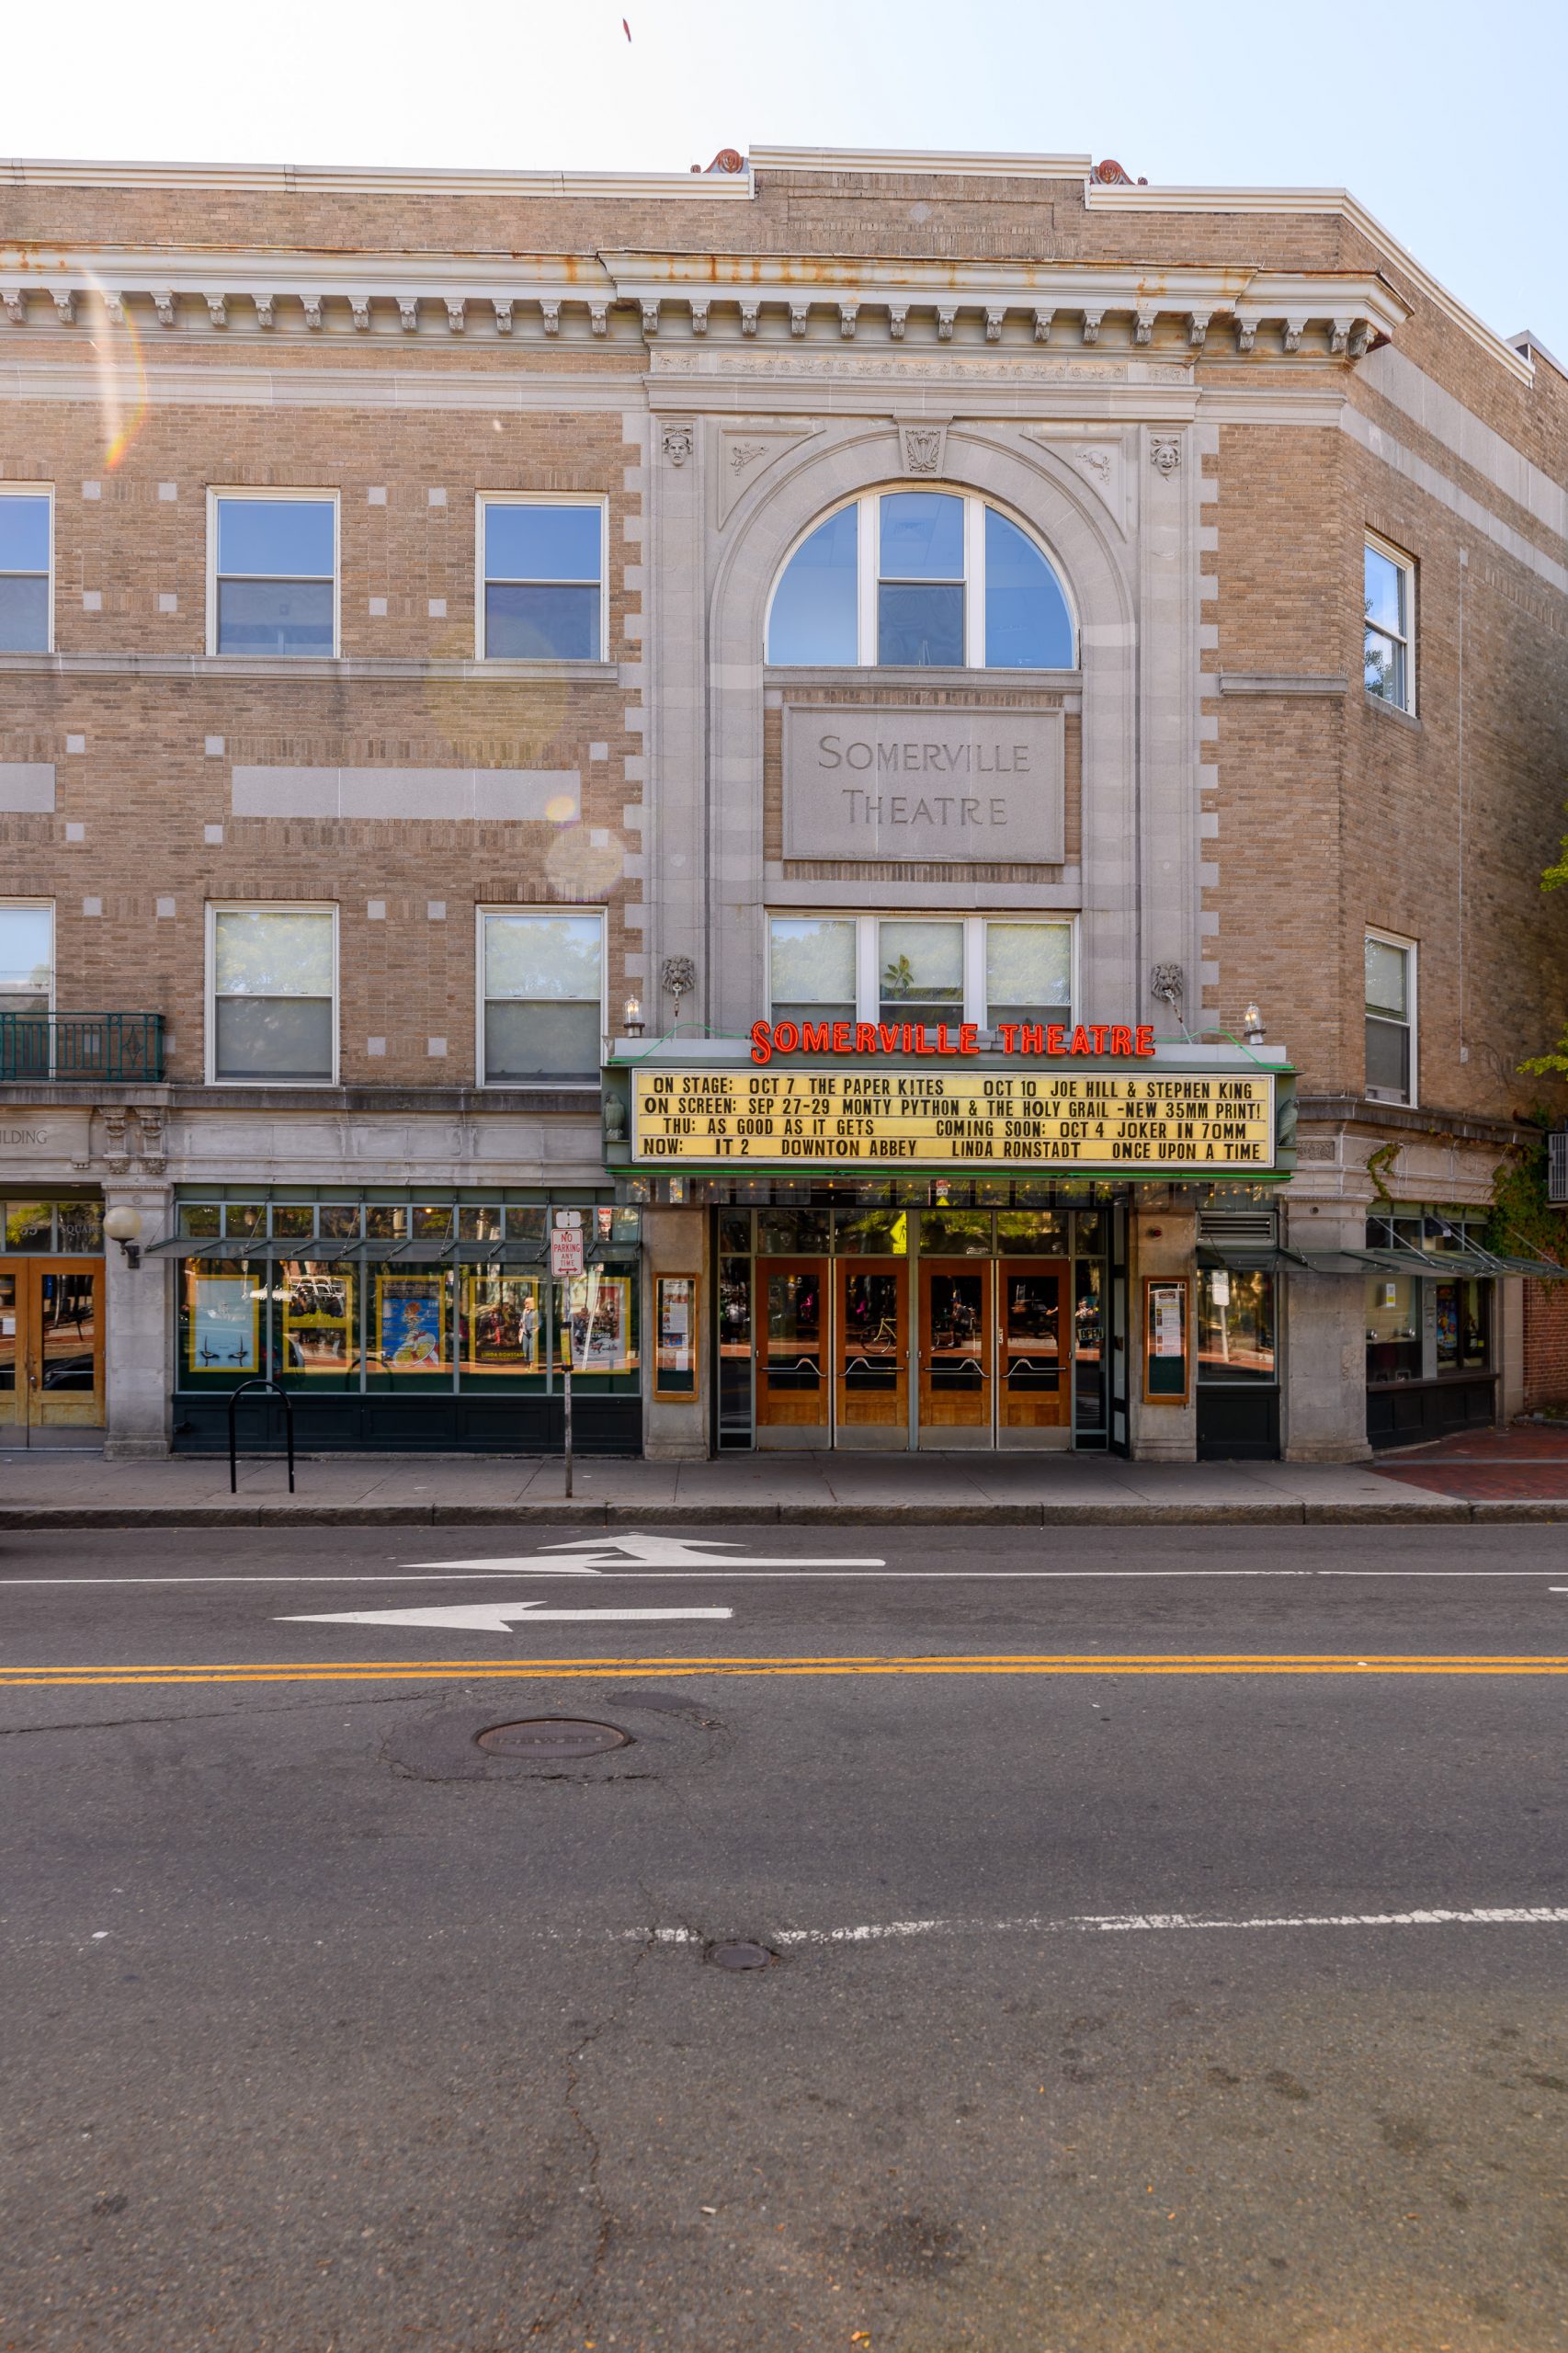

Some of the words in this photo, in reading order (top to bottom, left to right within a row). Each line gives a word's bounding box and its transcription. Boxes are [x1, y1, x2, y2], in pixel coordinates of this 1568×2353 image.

[818, 735, 1030, 772] SOMERVILLE
[842, 789, 1008, 825] THEATRE
[751, 1020, 980, 1064] SOMERVILLE
[999, 1024, 1155, 1056] THEATRE
[653, 1076, 674, 1094] ON
[683, 1077, 733, 1094] STAGE:
[749, 1078, 779, 1095] OCT
[787, 1078, 795, 1095] 7
[809, 1078, 835, 1096] THE
[844, 1079, 890, 1096] PAPER
[898, 1079, 944, 1097] KITES
[983, 1080, 1013, 1097] OCT
[1022, 1081, 1037, 1097] 10
[1051, 1081, 1077, 1098] JOE
[1086, 1082, 1118, 1098] HILL
[1127, 1082, 1136, 1098] &
[1147, 1082, 1210, 1099] STEPHEN
[1219, 1083, 1252, 1100] KING
[644, 1097, 668, 1114] ON
[678, 1097, 736, 1114] SCREEN:
[748, 1098, 774, 1115] SEP
[782, 1098, 830, 1115] 27-29
[842, 1099, 892, 1116] MONTY
[901, 1099, 959, 1117] PYTHON
[968, 1100, 977, 1117] &
[987, 1100, 1014, 1117] THE
[1023, 1101, 1061, 1118] HOLY
[1069, 1101, 1108, 1118] GRAIL
[1117, 1102, 1157, 1119] -NEW
[1165, 1102, 1208, 1120] 35MM
[1216, 1103, 1260, 1120] PRINT!
[664, 1117, 696, 1133] THU:
[707, 1118, 727, 1134] AS
[737, 1118, 773, 1134] GOOD
[784, 1118, 803, 1135] AS
[813, 1119, 826, 1135] IT
[837, 1119, 874, 1135] GETS
[936, 1120, 993, 1137] COMING
[1005, 1120, 1046, 1137] SOON:
[1060, 1121, 1088, 1138] OCT
[1095, 1121, 1104, 1138] 4
[1117, 1121, 1166, 1139] JOKER
[1177, 1122, 1193, 1139] IN
[1202, 1122, 1246, 1140] 70MM
[643, 1138, 683, 1155] NOW:
[715, 1139, 733, 1155] IT
[741, 1139, 749, 1155] 2
[781, 1140, 859, 1157] DOWNTON
[869, 1141, 916, 1157] ABBEY
[952, 1141, 993, 1158] LINDA
[1004, 1142, 1081, 1159] RONSTADT
[1112, 1142, 1150, 1159] ONCE
[1158, 1142, 1196, 1160] UPON
[1205, 1143, 1214, 1160] A
[1224, 1143, 1260, 1160] TIME
[61, 1224, 101, 1235] SQUARE
[562, 1233, 573, 1243] NO
[554, 1244, 581, 1253] PARKING
[1081, 1329, 1103, 1339] OPEN
